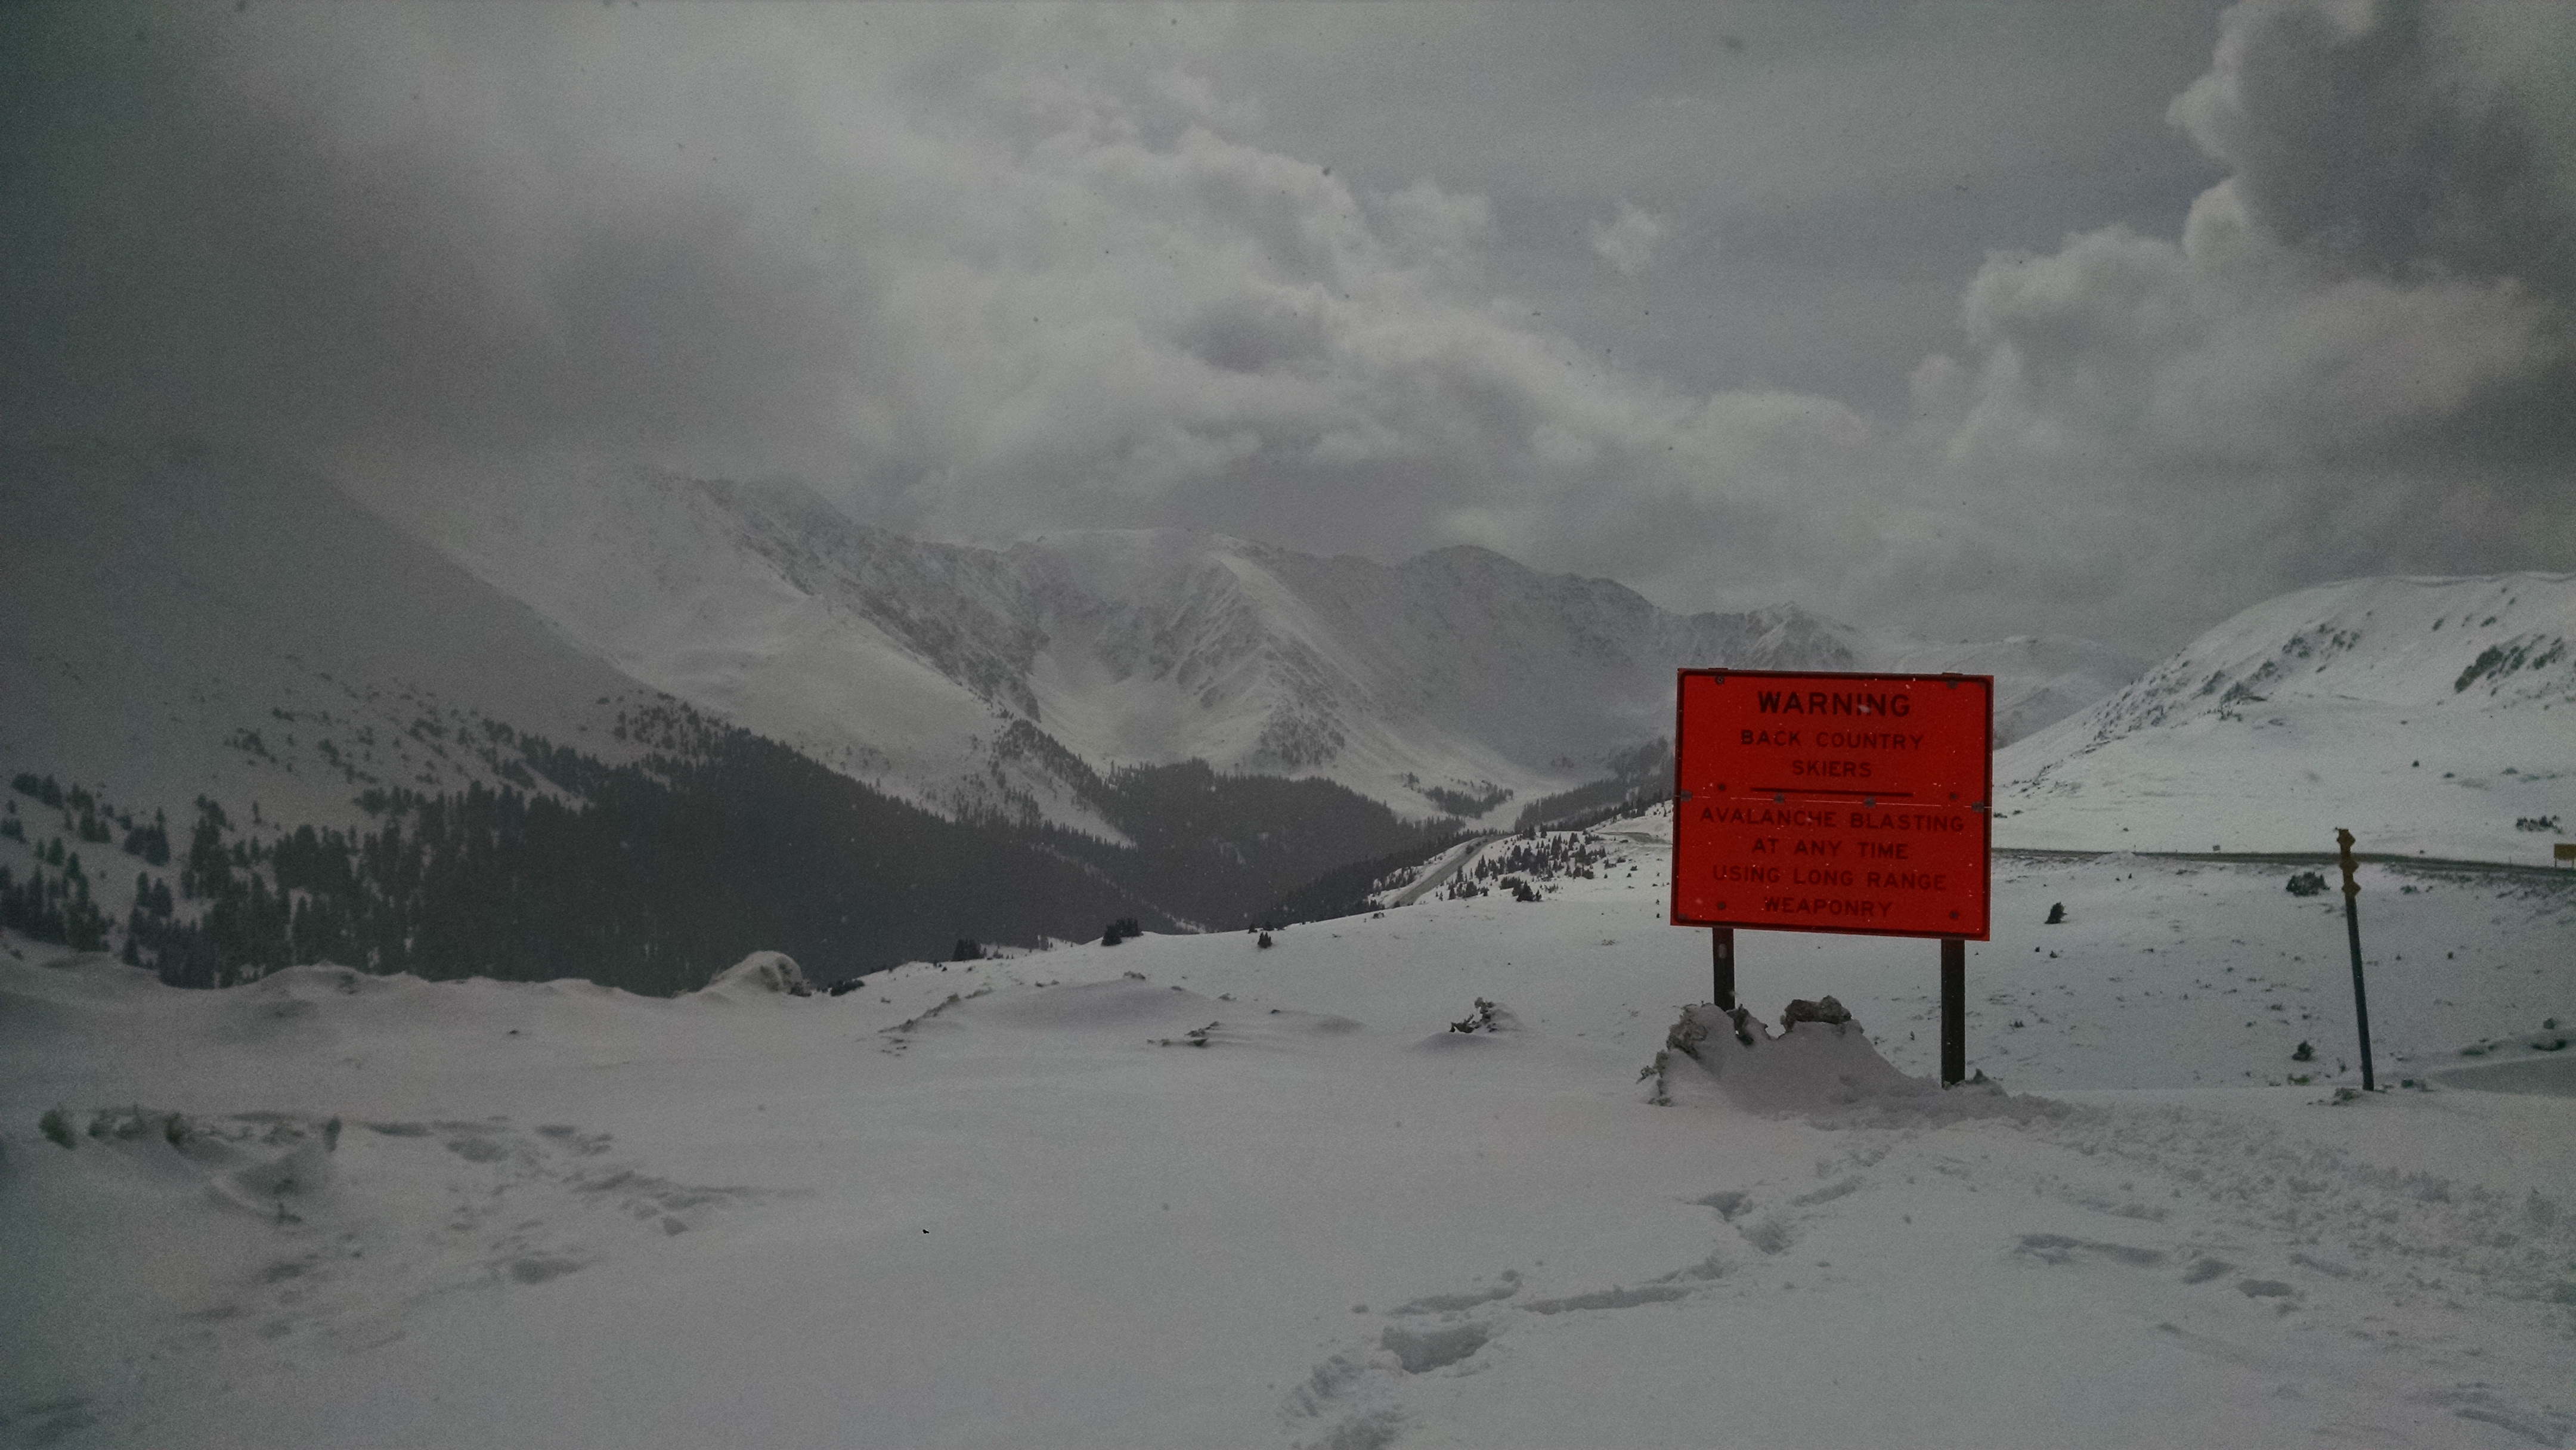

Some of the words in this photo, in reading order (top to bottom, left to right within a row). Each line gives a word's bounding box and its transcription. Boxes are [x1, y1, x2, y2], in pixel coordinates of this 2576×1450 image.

[1758, 690, 1911, 717] WARNING
[1741, 729, 1802, 746] BACK
[1816, 732, 1924, 750] COUNTRY
[1792, 760, 1872, 777] SKIERS
[1699, 807, 1837, 828] AVALANCHE
[1850, 812, 1964, 832] BLASTING
[1751, 838, 1779, 854] AT
[1794, 840, 1842, 857] ANY
[1857, 842, 1909, 860] TIME
[1713, 866, 1780, 883] USING
[1793, 869, 1854, 886] LONG
[1867, 871, 1946, 890] RANGE
[1764, 896, 1893, 917] WEAPONRY
